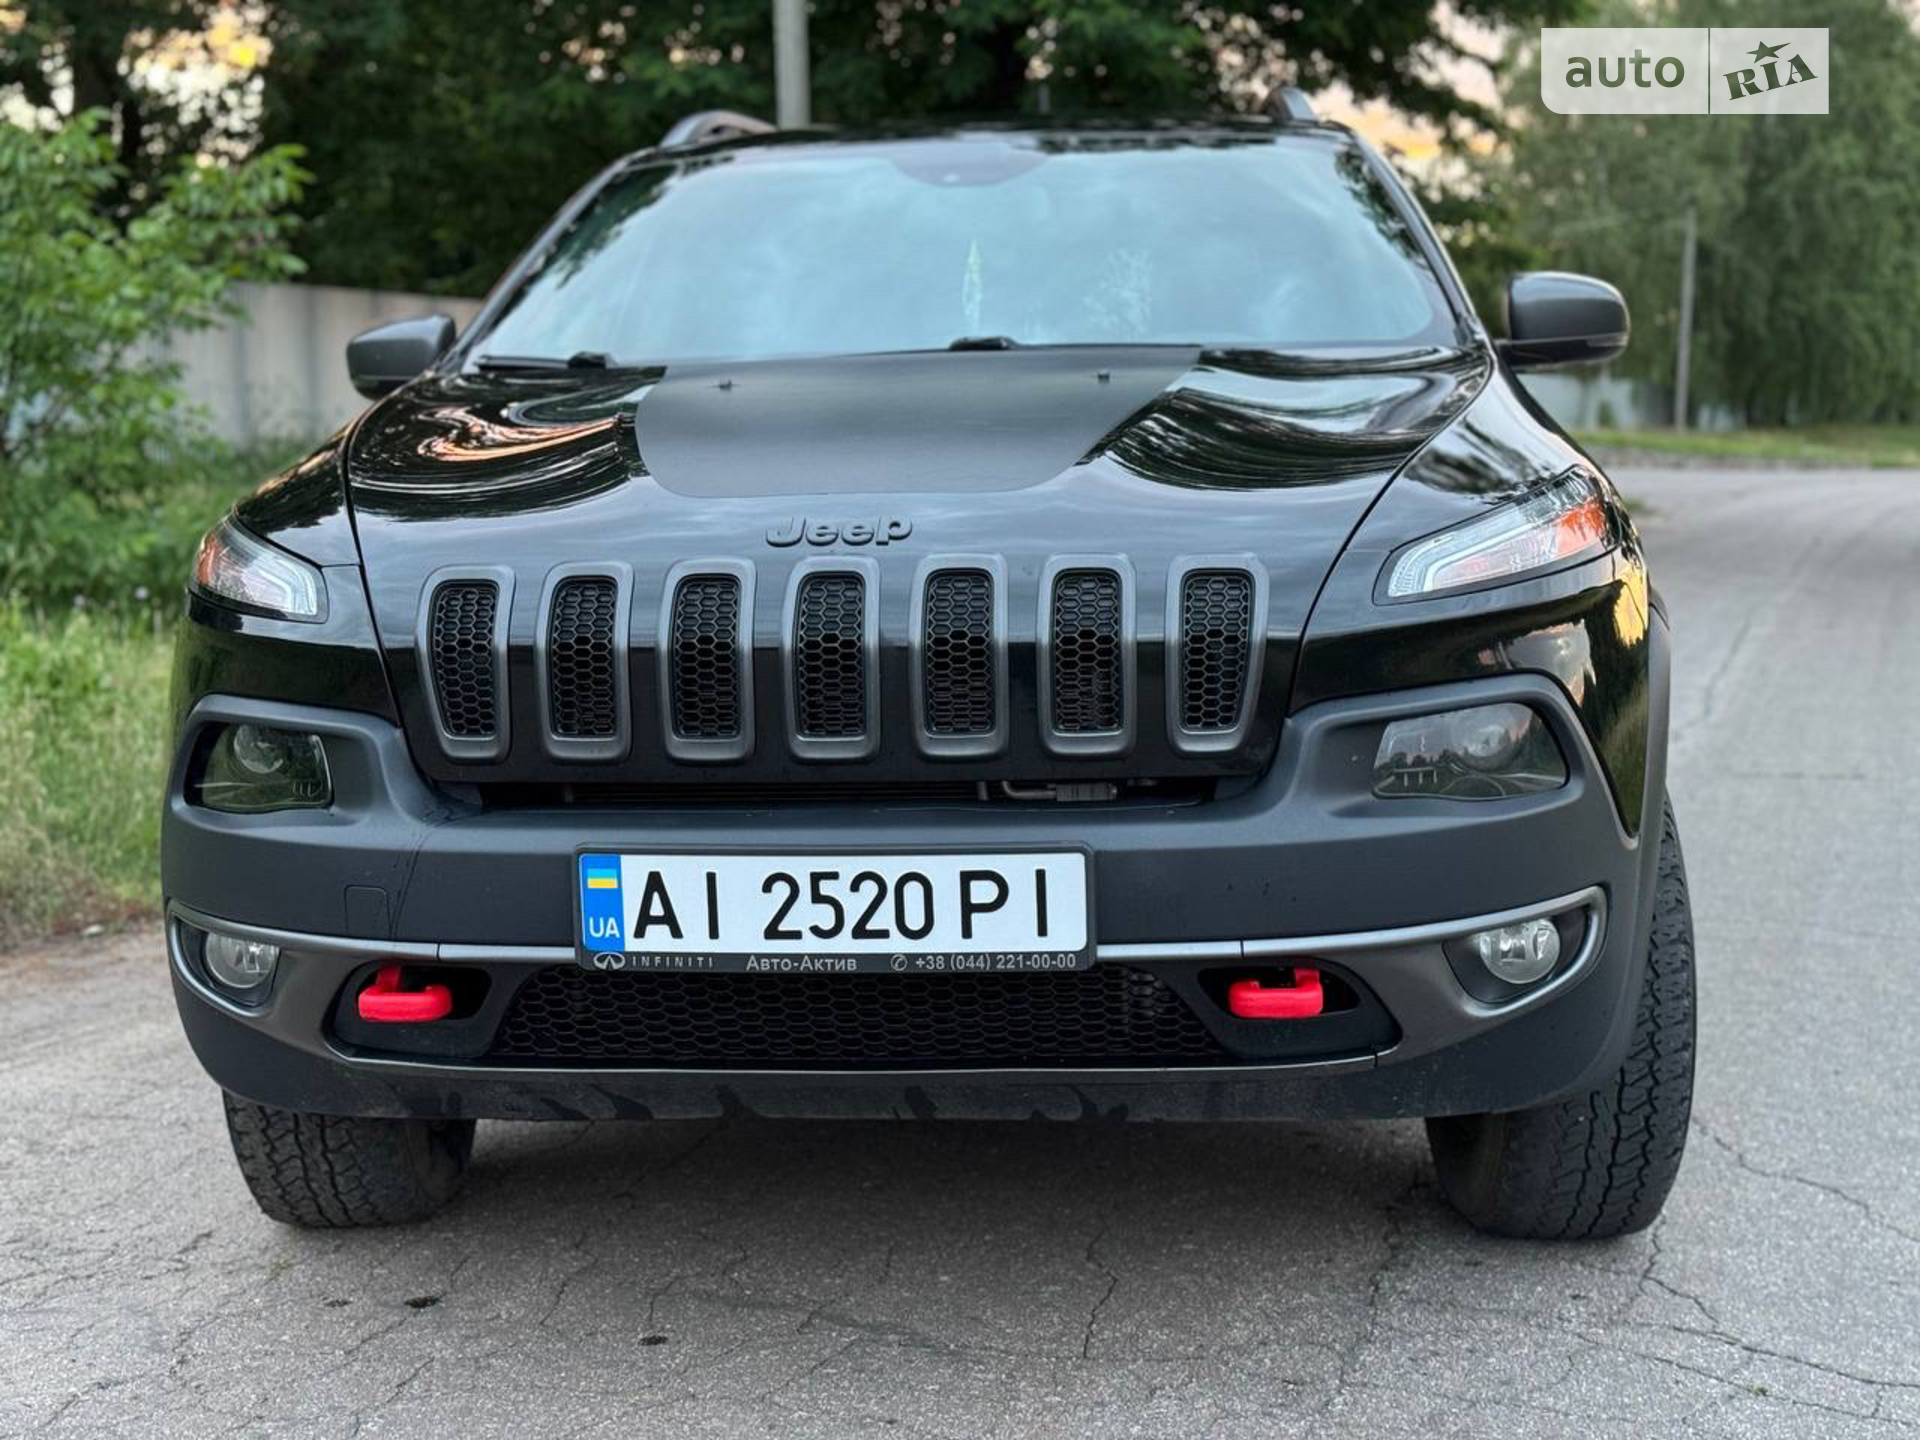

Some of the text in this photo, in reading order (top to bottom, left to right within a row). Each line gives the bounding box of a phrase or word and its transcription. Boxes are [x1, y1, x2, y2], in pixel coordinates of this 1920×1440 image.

[765, 515, 913, 548] Jeep
[761, 870, 935, 941] 2520
[589, 917, 620, 938] UA
[632, 956, 714, 969] INFINITI
[746, 955, 857, 971] Авто-Актив
[915, 953, 1076, 972] +38 (044) 221-00-00
